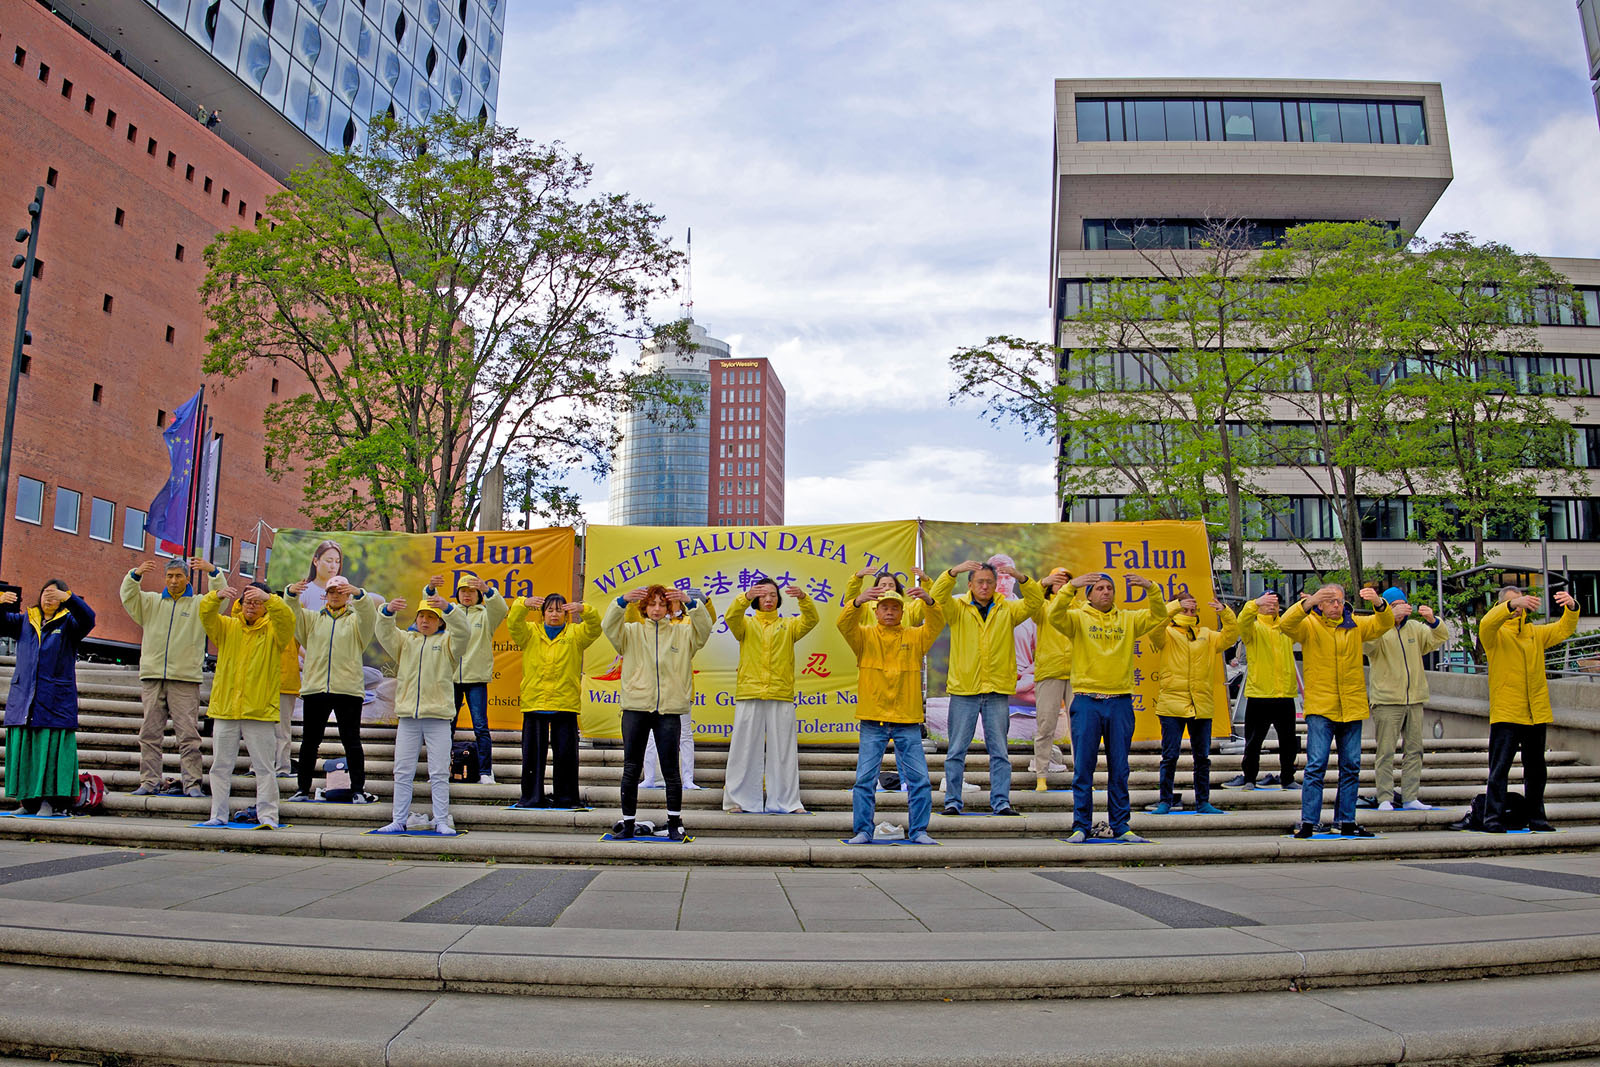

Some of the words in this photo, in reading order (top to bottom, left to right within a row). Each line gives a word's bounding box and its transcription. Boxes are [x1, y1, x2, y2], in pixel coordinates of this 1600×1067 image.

[432, 535, 534, 564] Falun
[593, 545, 662, 594] WELT
[675, 531, 768, 560] FALUN
[776, 532, 847, 565] DAFA
[1102, 540, 1187, 569] Falun
[801, 653, 831, 678] 忍
